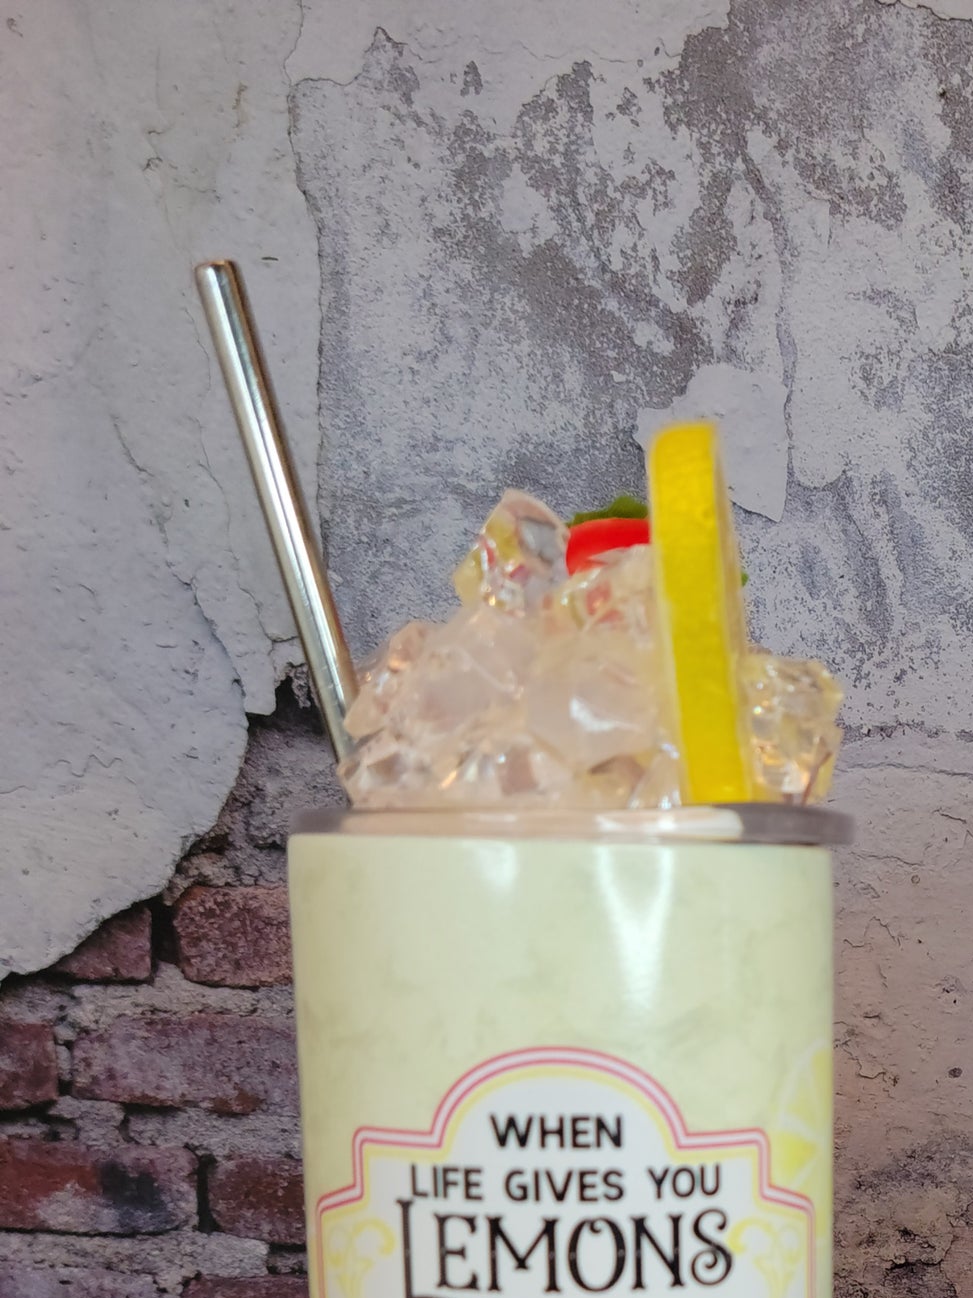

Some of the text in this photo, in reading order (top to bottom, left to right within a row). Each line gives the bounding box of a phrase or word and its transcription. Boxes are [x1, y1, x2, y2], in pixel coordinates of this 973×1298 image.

[489, 1113, 624, 1150] WHEN
[410, 1163, 721, 1202] LIFE GIVES YOU
